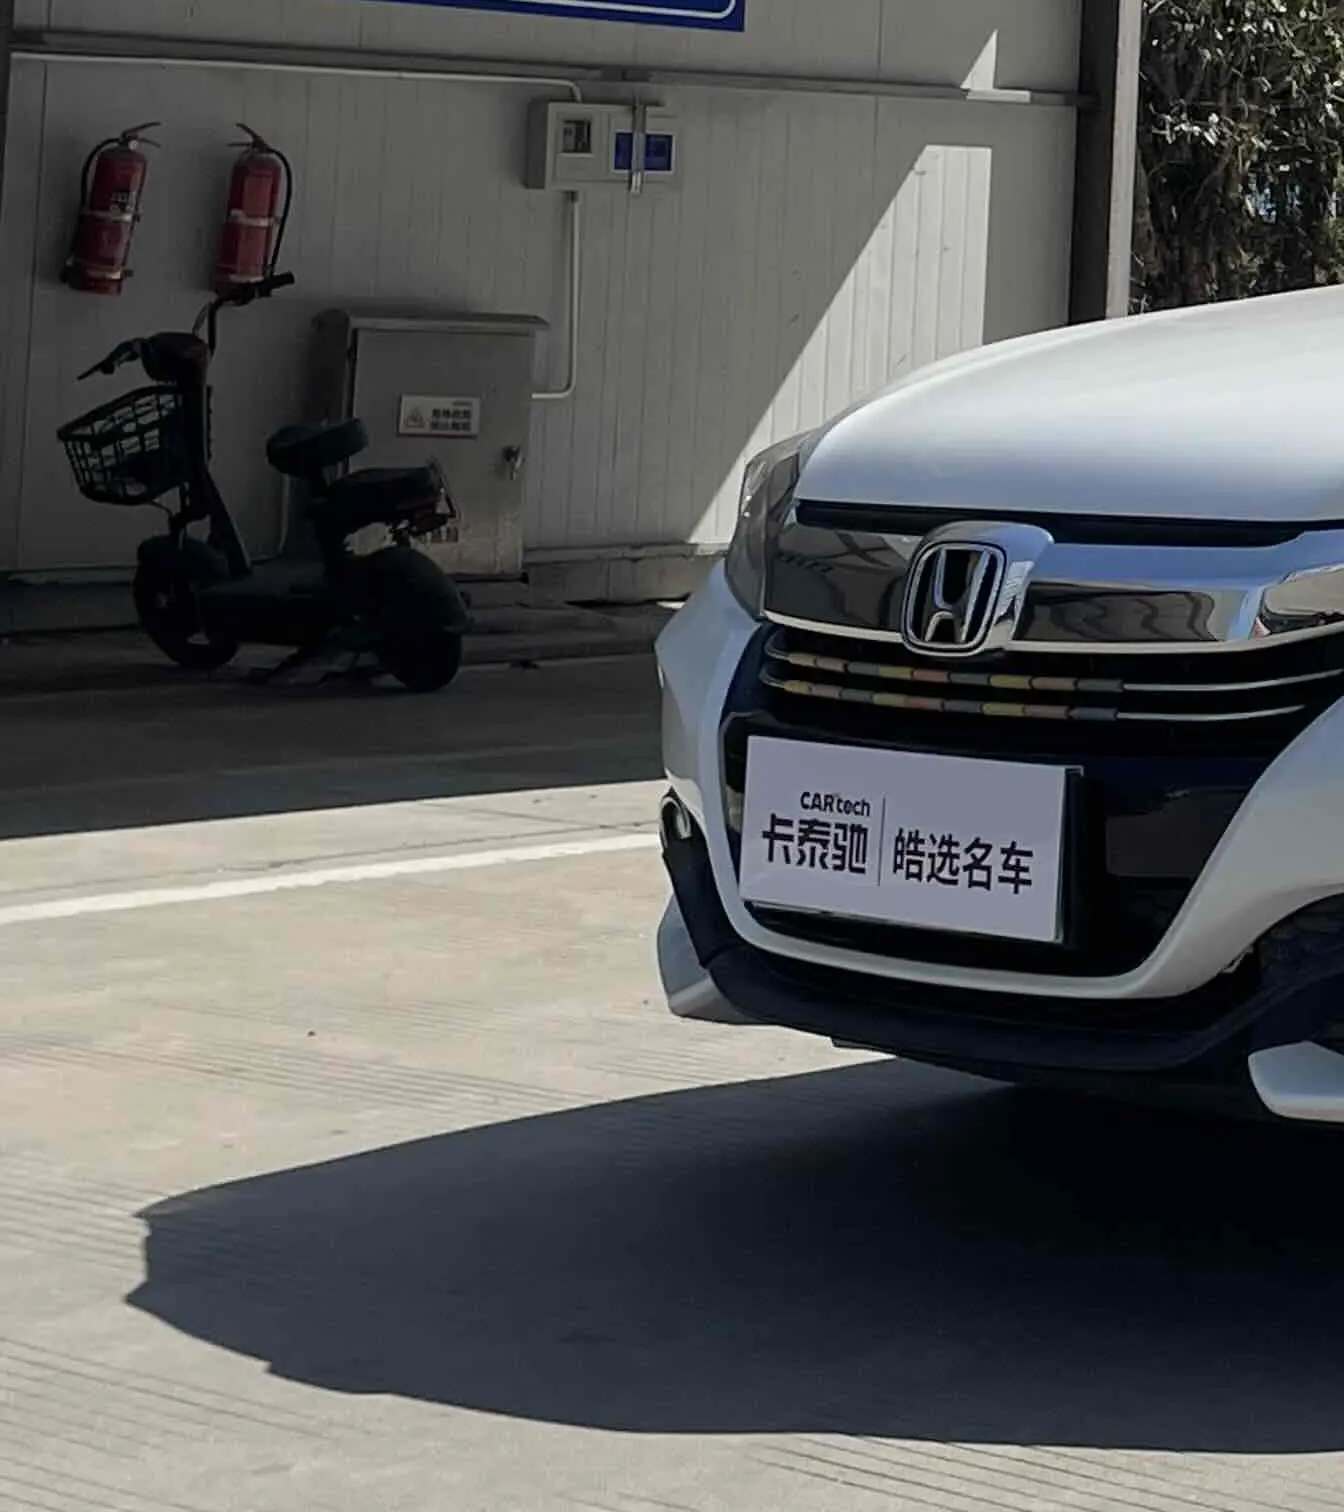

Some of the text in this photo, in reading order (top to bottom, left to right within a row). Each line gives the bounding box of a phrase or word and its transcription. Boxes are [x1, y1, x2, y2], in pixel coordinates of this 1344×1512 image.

[800, 791, 871, 817] CARtech
[761, 812, 1034, 895] 卡泰驰 皓选名车
